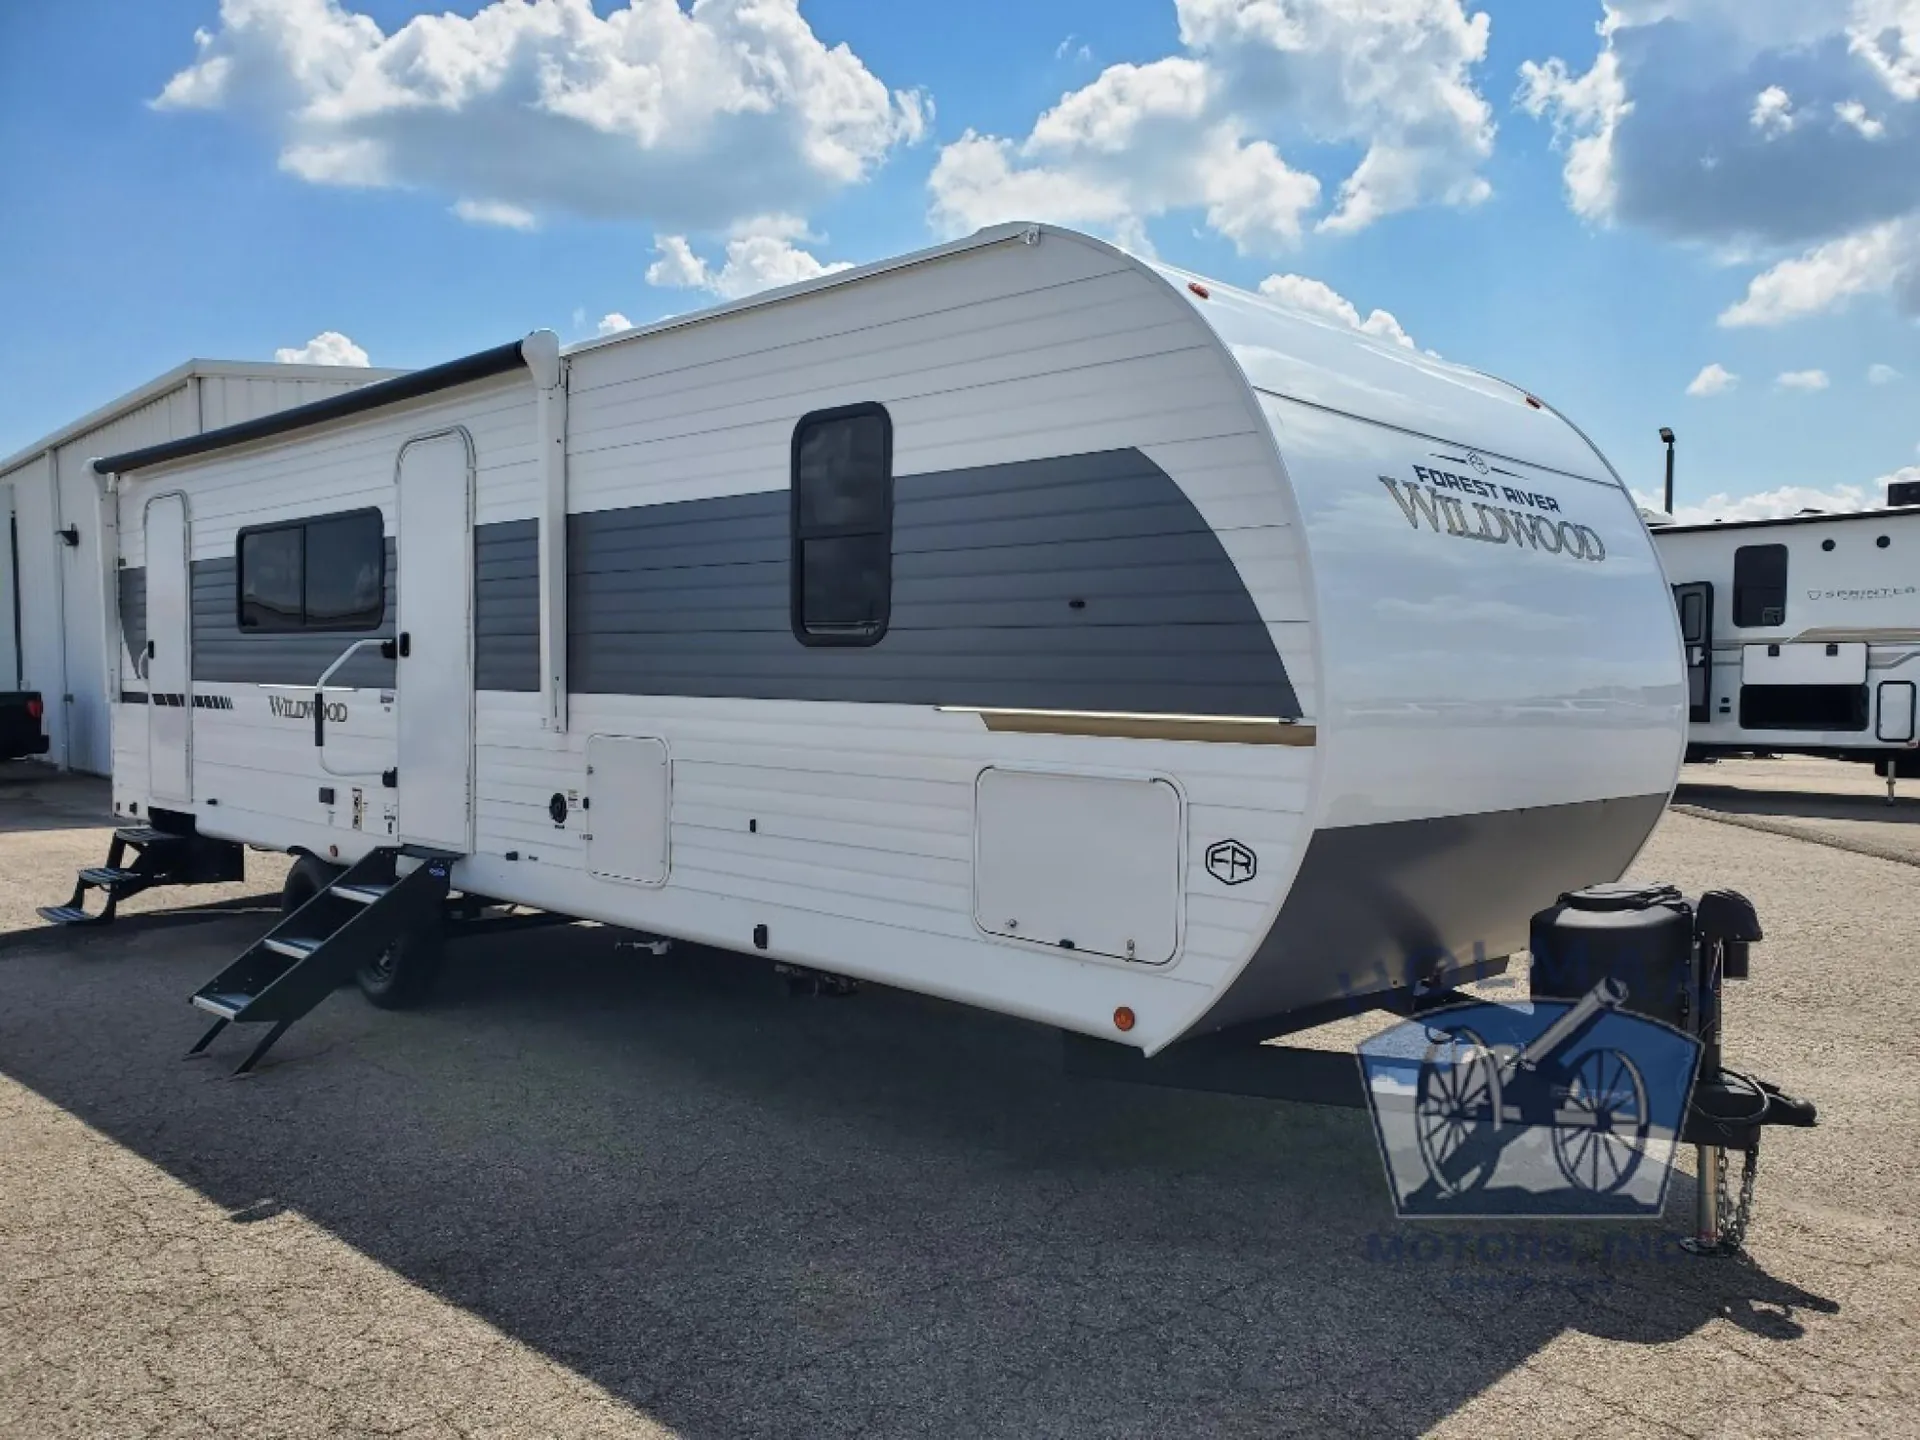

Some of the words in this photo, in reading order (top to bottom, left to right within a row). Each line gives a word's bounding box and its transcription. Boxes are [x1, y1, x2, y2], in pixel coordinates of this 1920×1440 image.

[1378, 474, 1606, 562] WILDWOOD
[1412, 464, 1499, 500] FOREST
[1502, 486, 1561, 514] RIVER
